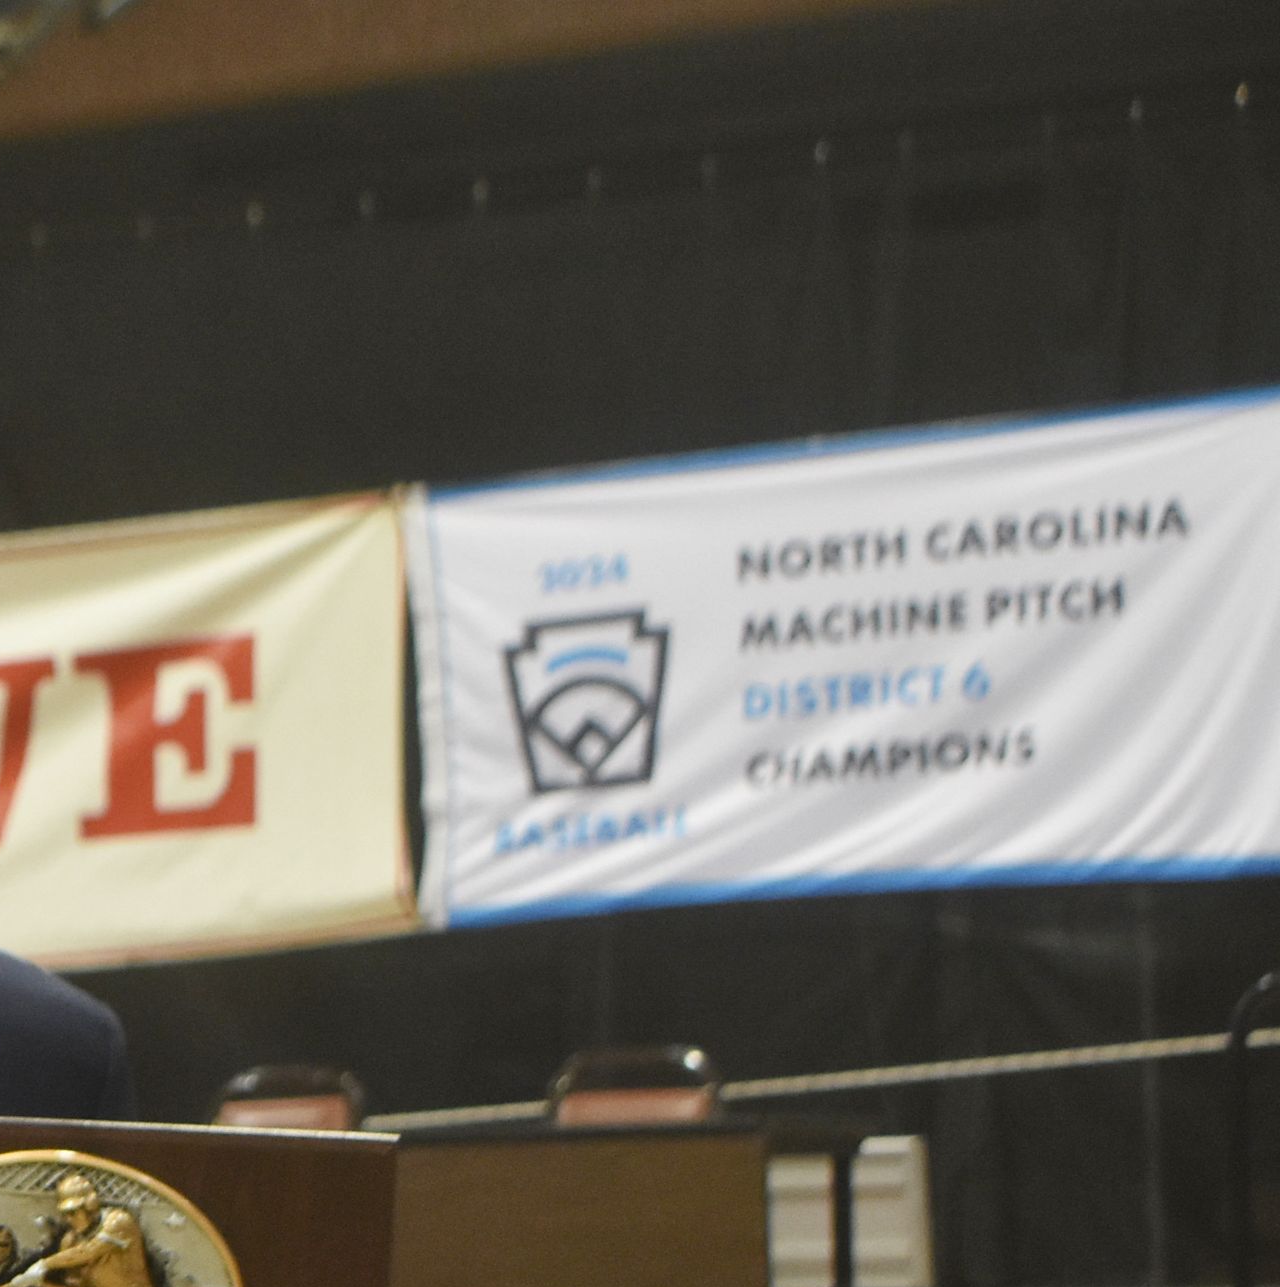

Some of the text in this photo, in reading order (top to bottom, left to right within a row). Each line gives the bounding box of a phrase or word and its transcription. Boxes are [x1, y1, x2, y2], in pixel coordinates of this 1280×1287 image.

[737, 498, 1190, 584] NORTH CAROLINA
[739, 579, 1127, 651] MACHINE PITCH
[744, 665, 992, 722] DISTRICT 6
[746, 726, 1035, 788] CHAMPIONS
